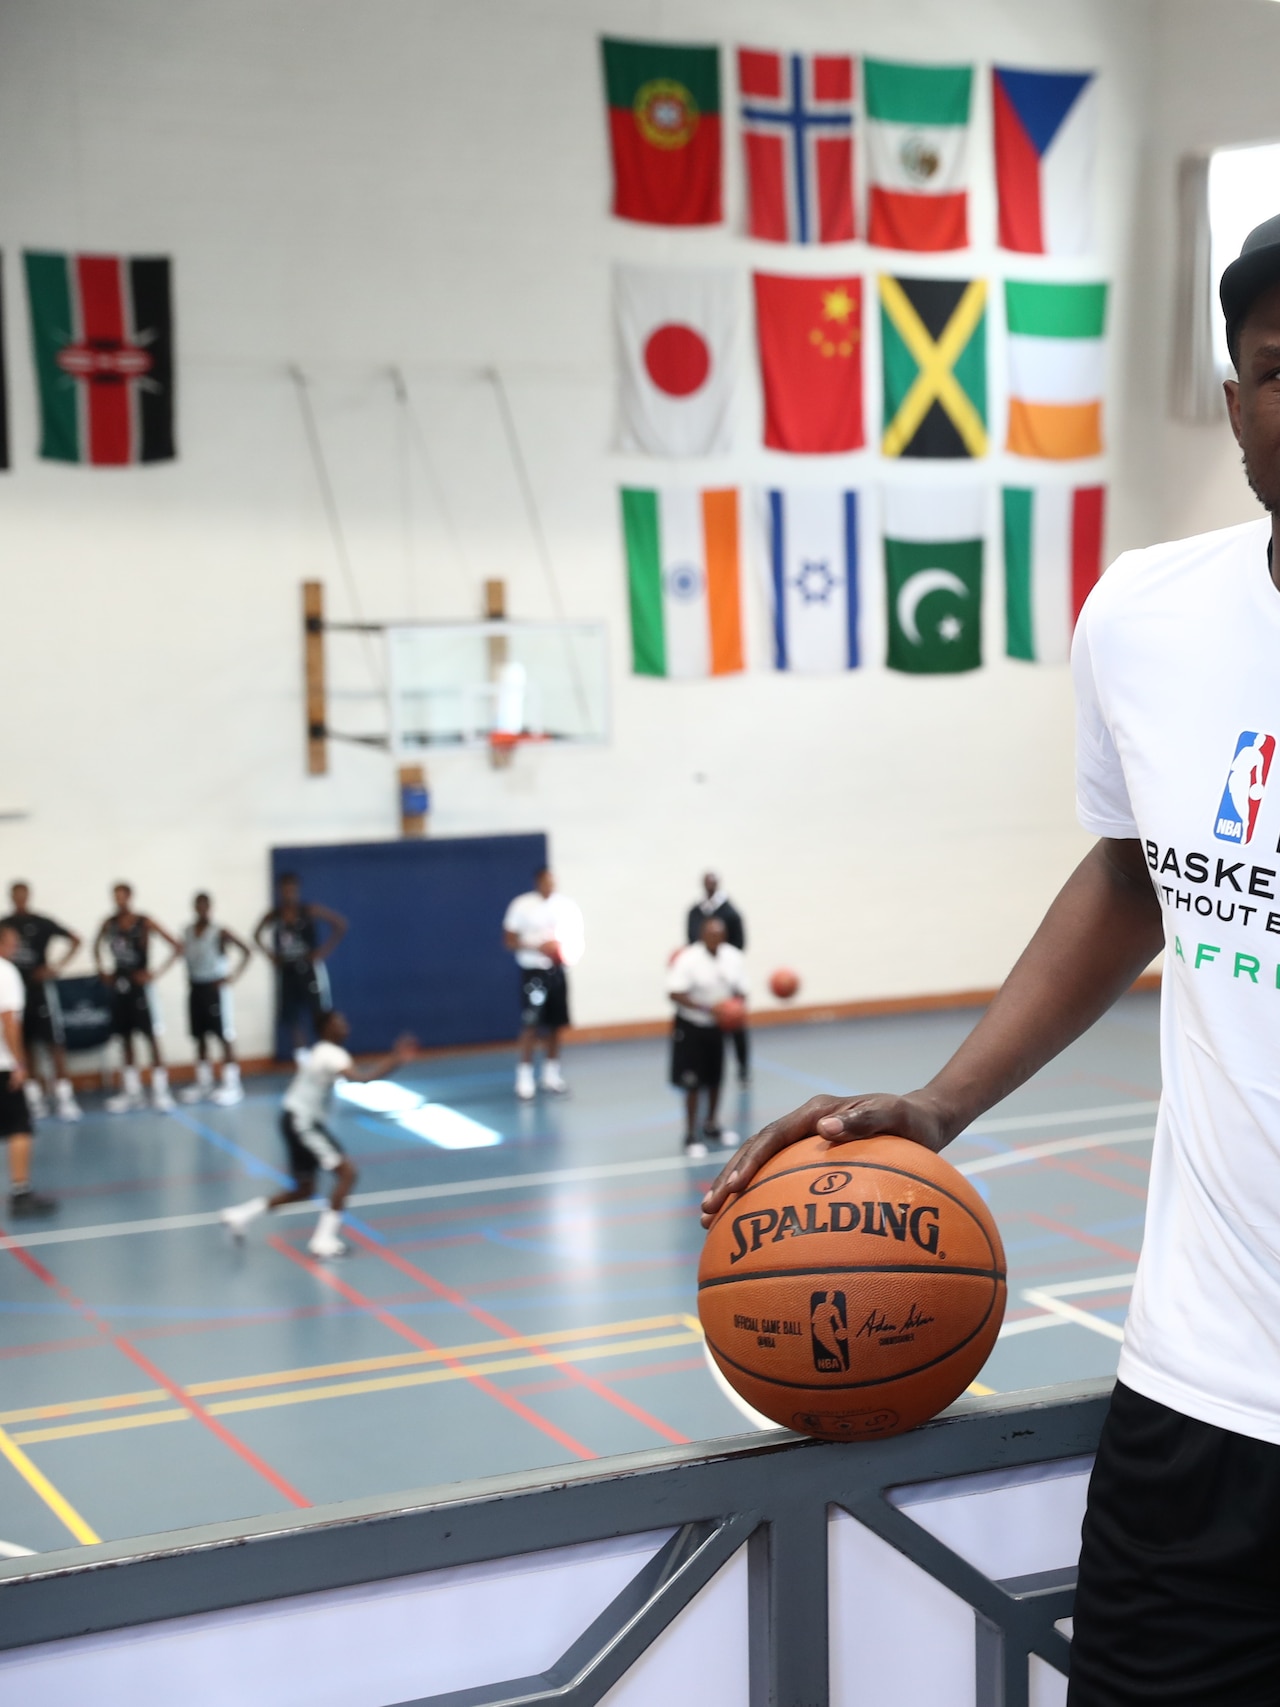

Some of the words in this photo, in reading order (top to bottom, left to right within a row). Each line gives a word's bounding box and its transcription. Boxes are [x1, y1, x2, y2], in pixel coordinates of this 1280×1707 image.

[1216, 818, 1242, 838] NBA
[731, 1201, 940, 1265] SPALDING
[762, 1319, 782, 1335] GAME
[783, 1320, 803, 1336] BALL
[817, 1358, 840, 1370] NBA
